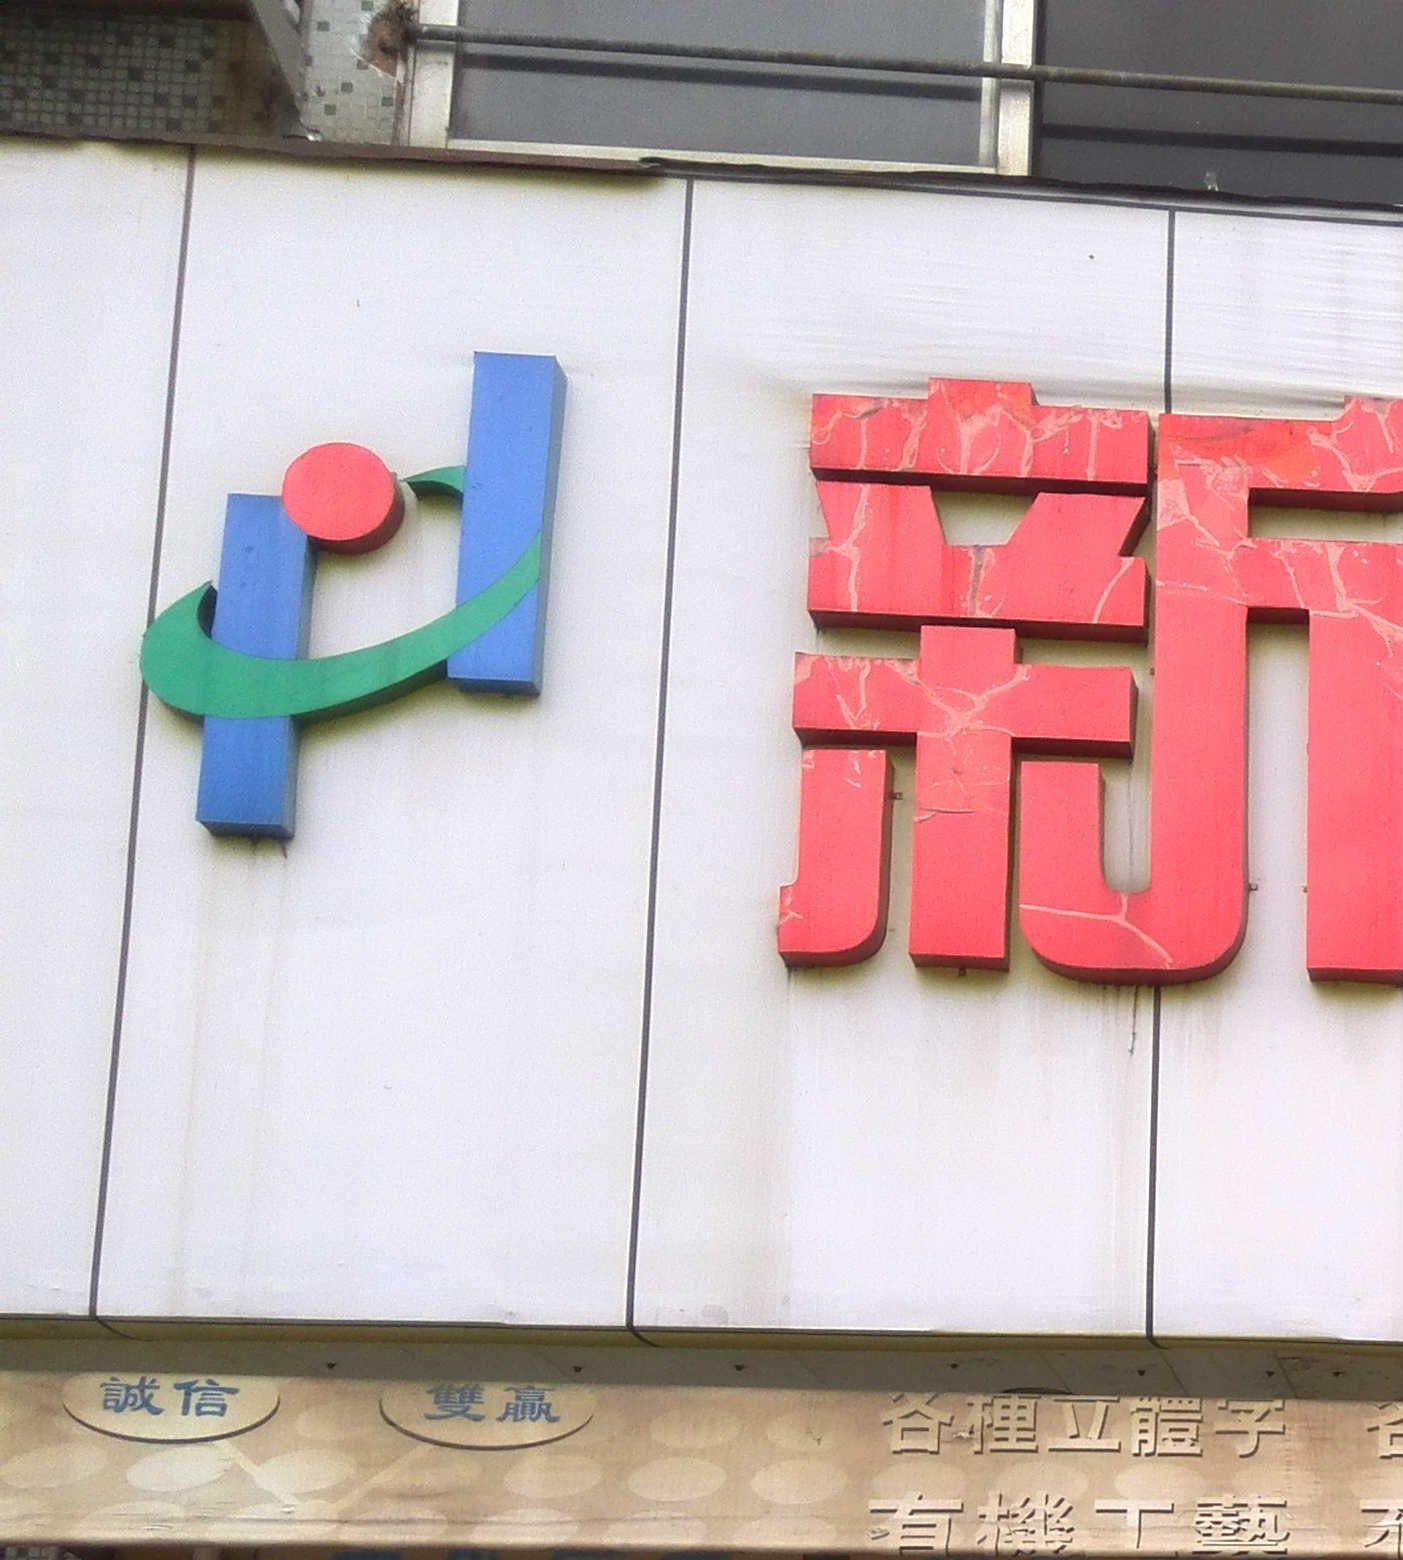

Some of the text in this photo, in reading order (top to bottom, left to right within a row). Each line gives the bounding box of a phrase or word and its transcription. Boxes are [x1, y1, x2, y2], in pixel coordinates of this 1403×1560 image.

[100, 1376, 240, 1418] 誠信
[882, 1394, 1287, 1460] 各種立體字
